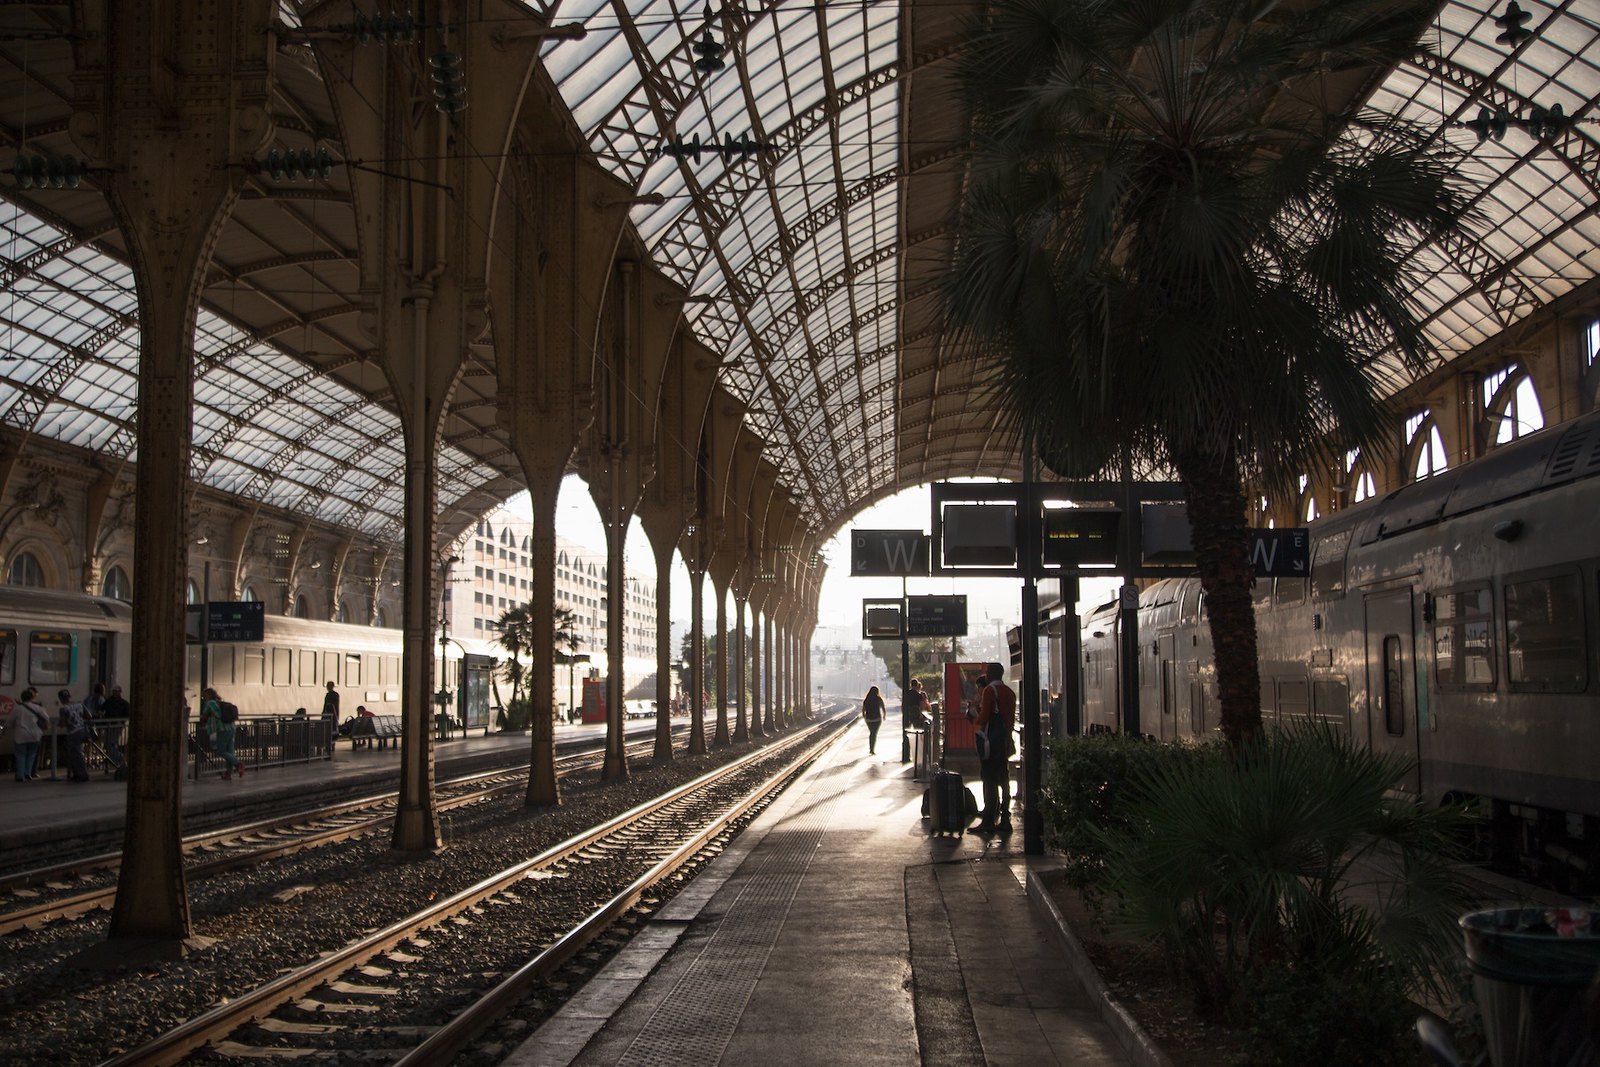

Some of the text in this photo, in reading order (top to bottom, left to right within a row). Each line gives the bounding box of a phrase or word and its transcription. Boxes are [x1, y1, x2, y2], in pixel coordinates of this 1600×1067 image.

[856, 537, 866, 548] D
[1294, 537, 1303, 547] E
[883, 539, 918, 572] W
